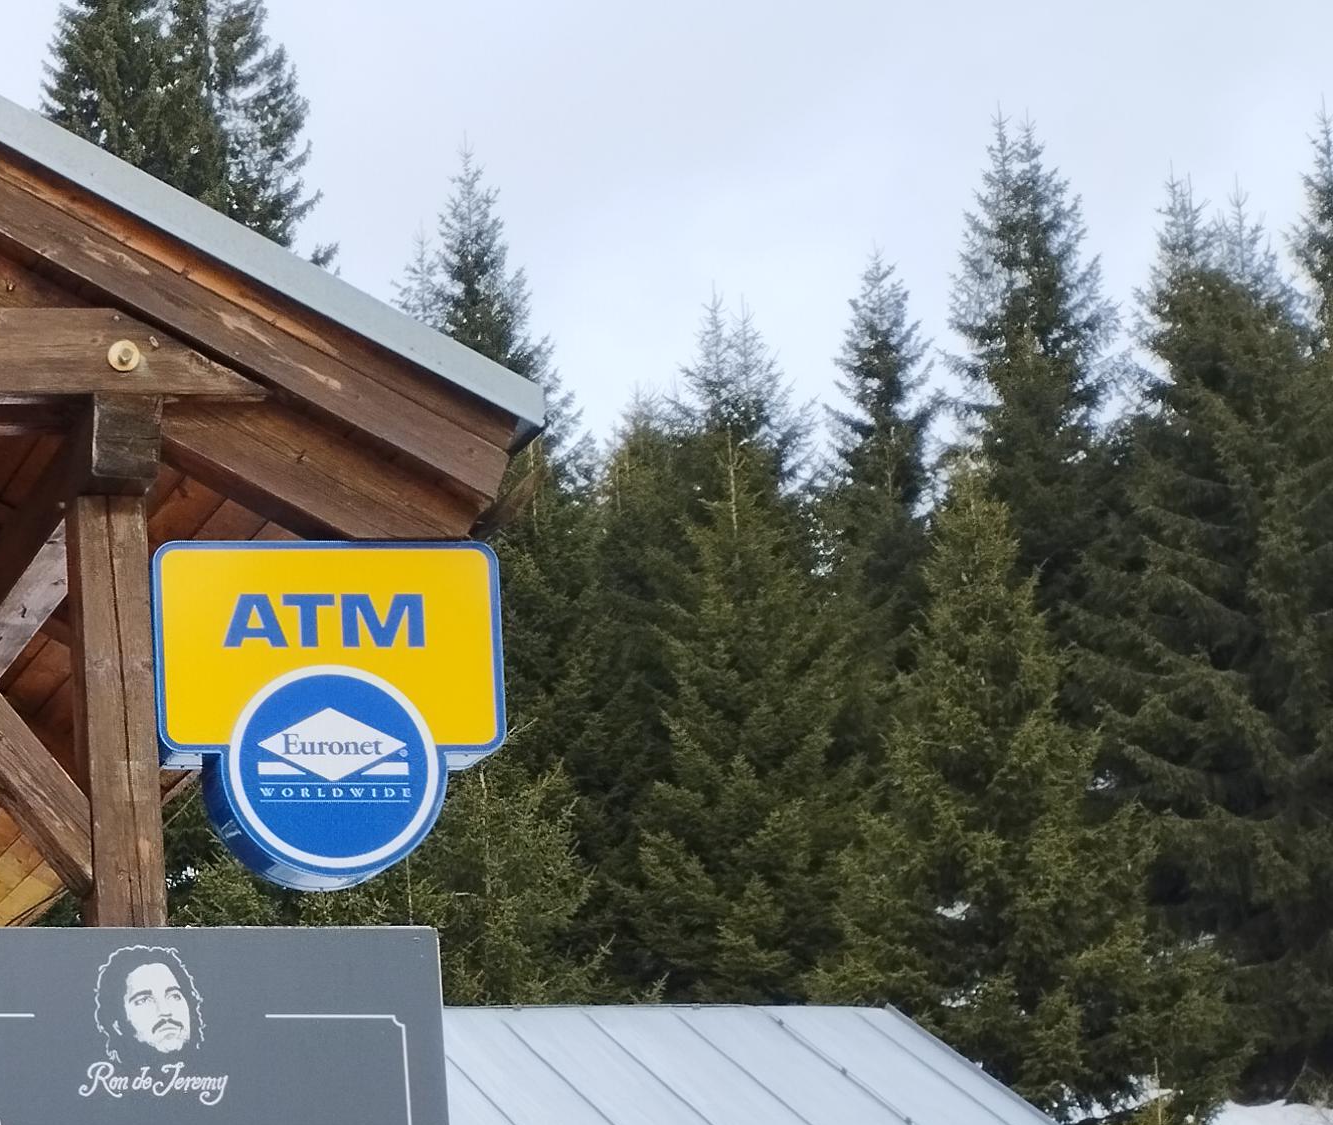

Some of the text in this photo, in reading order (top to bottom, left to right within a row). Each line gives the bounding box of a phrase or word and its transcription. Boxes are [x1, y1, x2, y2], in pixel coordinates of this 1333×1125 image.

[223, 593, 426, 648] ATM
[282, 733, 383, 757] Euronet
[260, 787, 412, 798] WORLDWIDE
[78, 1061, 129, 1098] Ron
[152, 1061, 228, 1106] Jeremy
